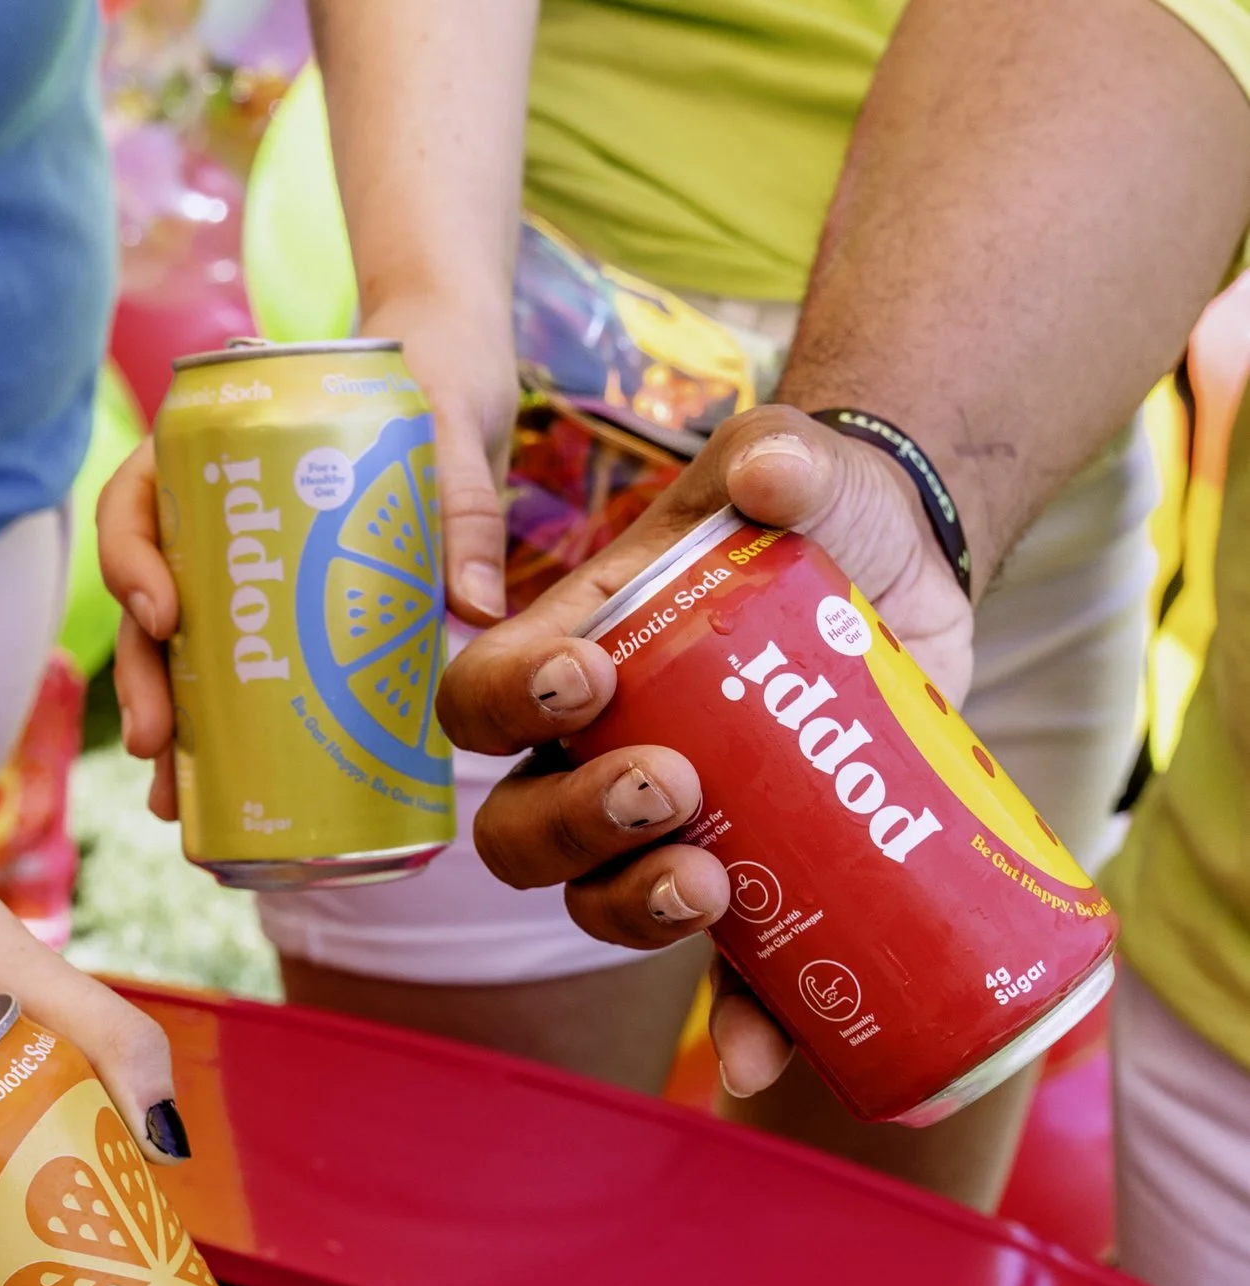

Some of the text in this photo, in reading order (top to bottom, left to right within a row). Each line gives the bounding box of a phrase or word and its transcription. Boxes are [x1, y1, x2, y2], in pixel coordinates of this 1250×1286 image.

[203, 455, 291, 686] poppi
[612, 607, 678, 666] ebiotic
[674, 567, 732, 610] Soda
[824, 610, 842, 626] For
[827, 615, 860, 641] Healthy
[845, 630, 862, 644] Gut
[721, 640, 943, 864] poppi
[708, 809, 724, 823] for
[714, 820, 733, 835] Gut
[970, 833, 991, 858] Be
[992, 852, 1020, 882] Gut
[1020, 874, 1074, 914] Happy.
[1074, 900, 1094, 918] Be
[756, 909, 824, 960] Apple Cider Vinegar
[757, 909, 802, 943] Infused with
[985, 966, 1012, 990] 4g
[994, 959, 1047, 1006] Sugar
[839, 1012, 875, 1039] Immunity
[849, 1023, 882, 1047] Sidekick
[23, 1031, 57, 1062] Soda
